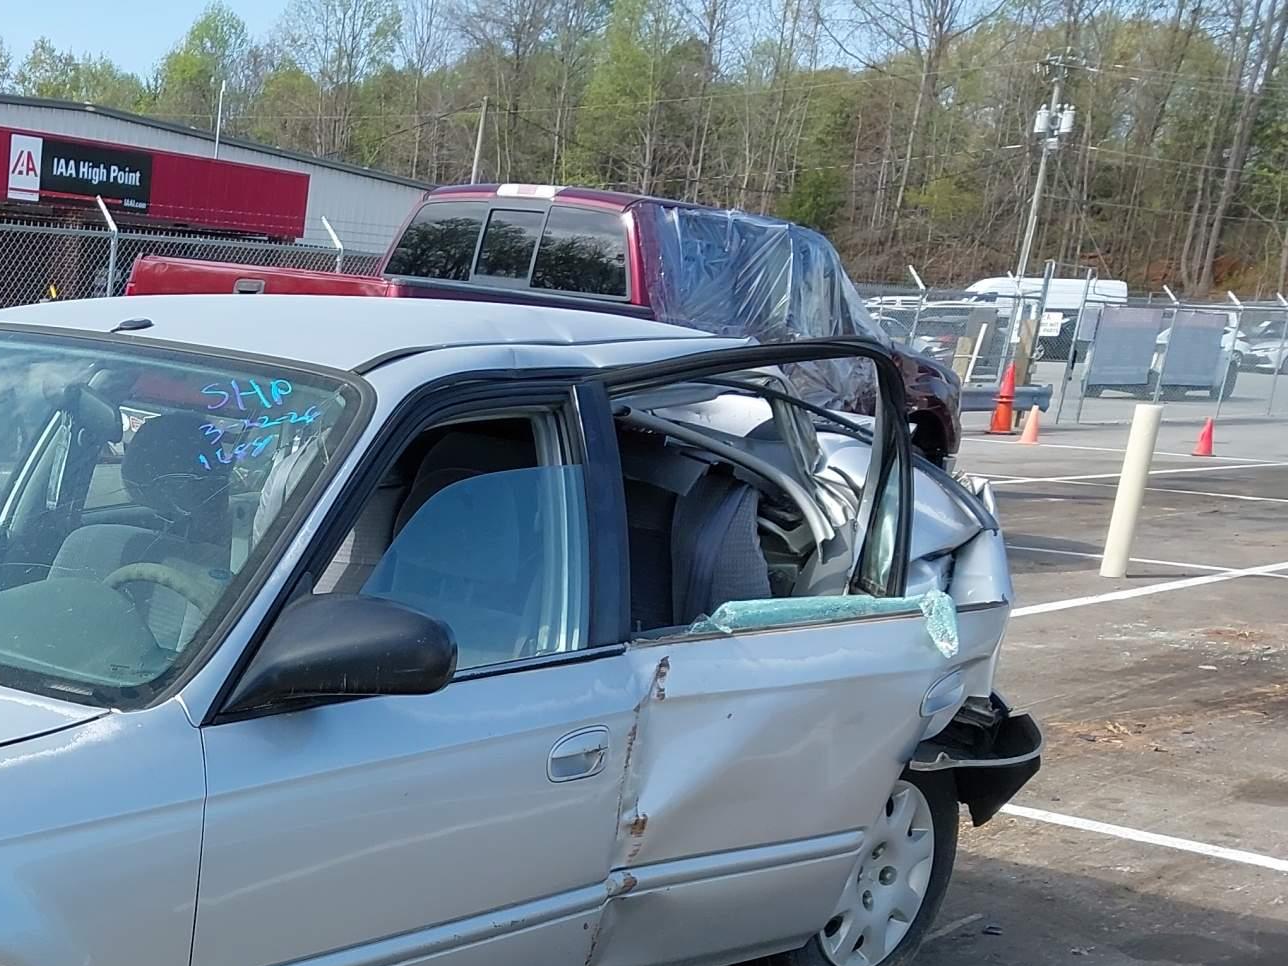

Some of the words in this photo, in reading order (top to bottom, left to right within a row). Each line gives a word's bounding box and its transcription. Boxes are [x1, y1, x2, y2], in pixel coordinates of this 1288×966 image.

[53, 157, 76, 178] IAA
[79, 160, 107, 185] High
[110, 165, 141, 186] Point
[200, 378, 292, 411] SHP
